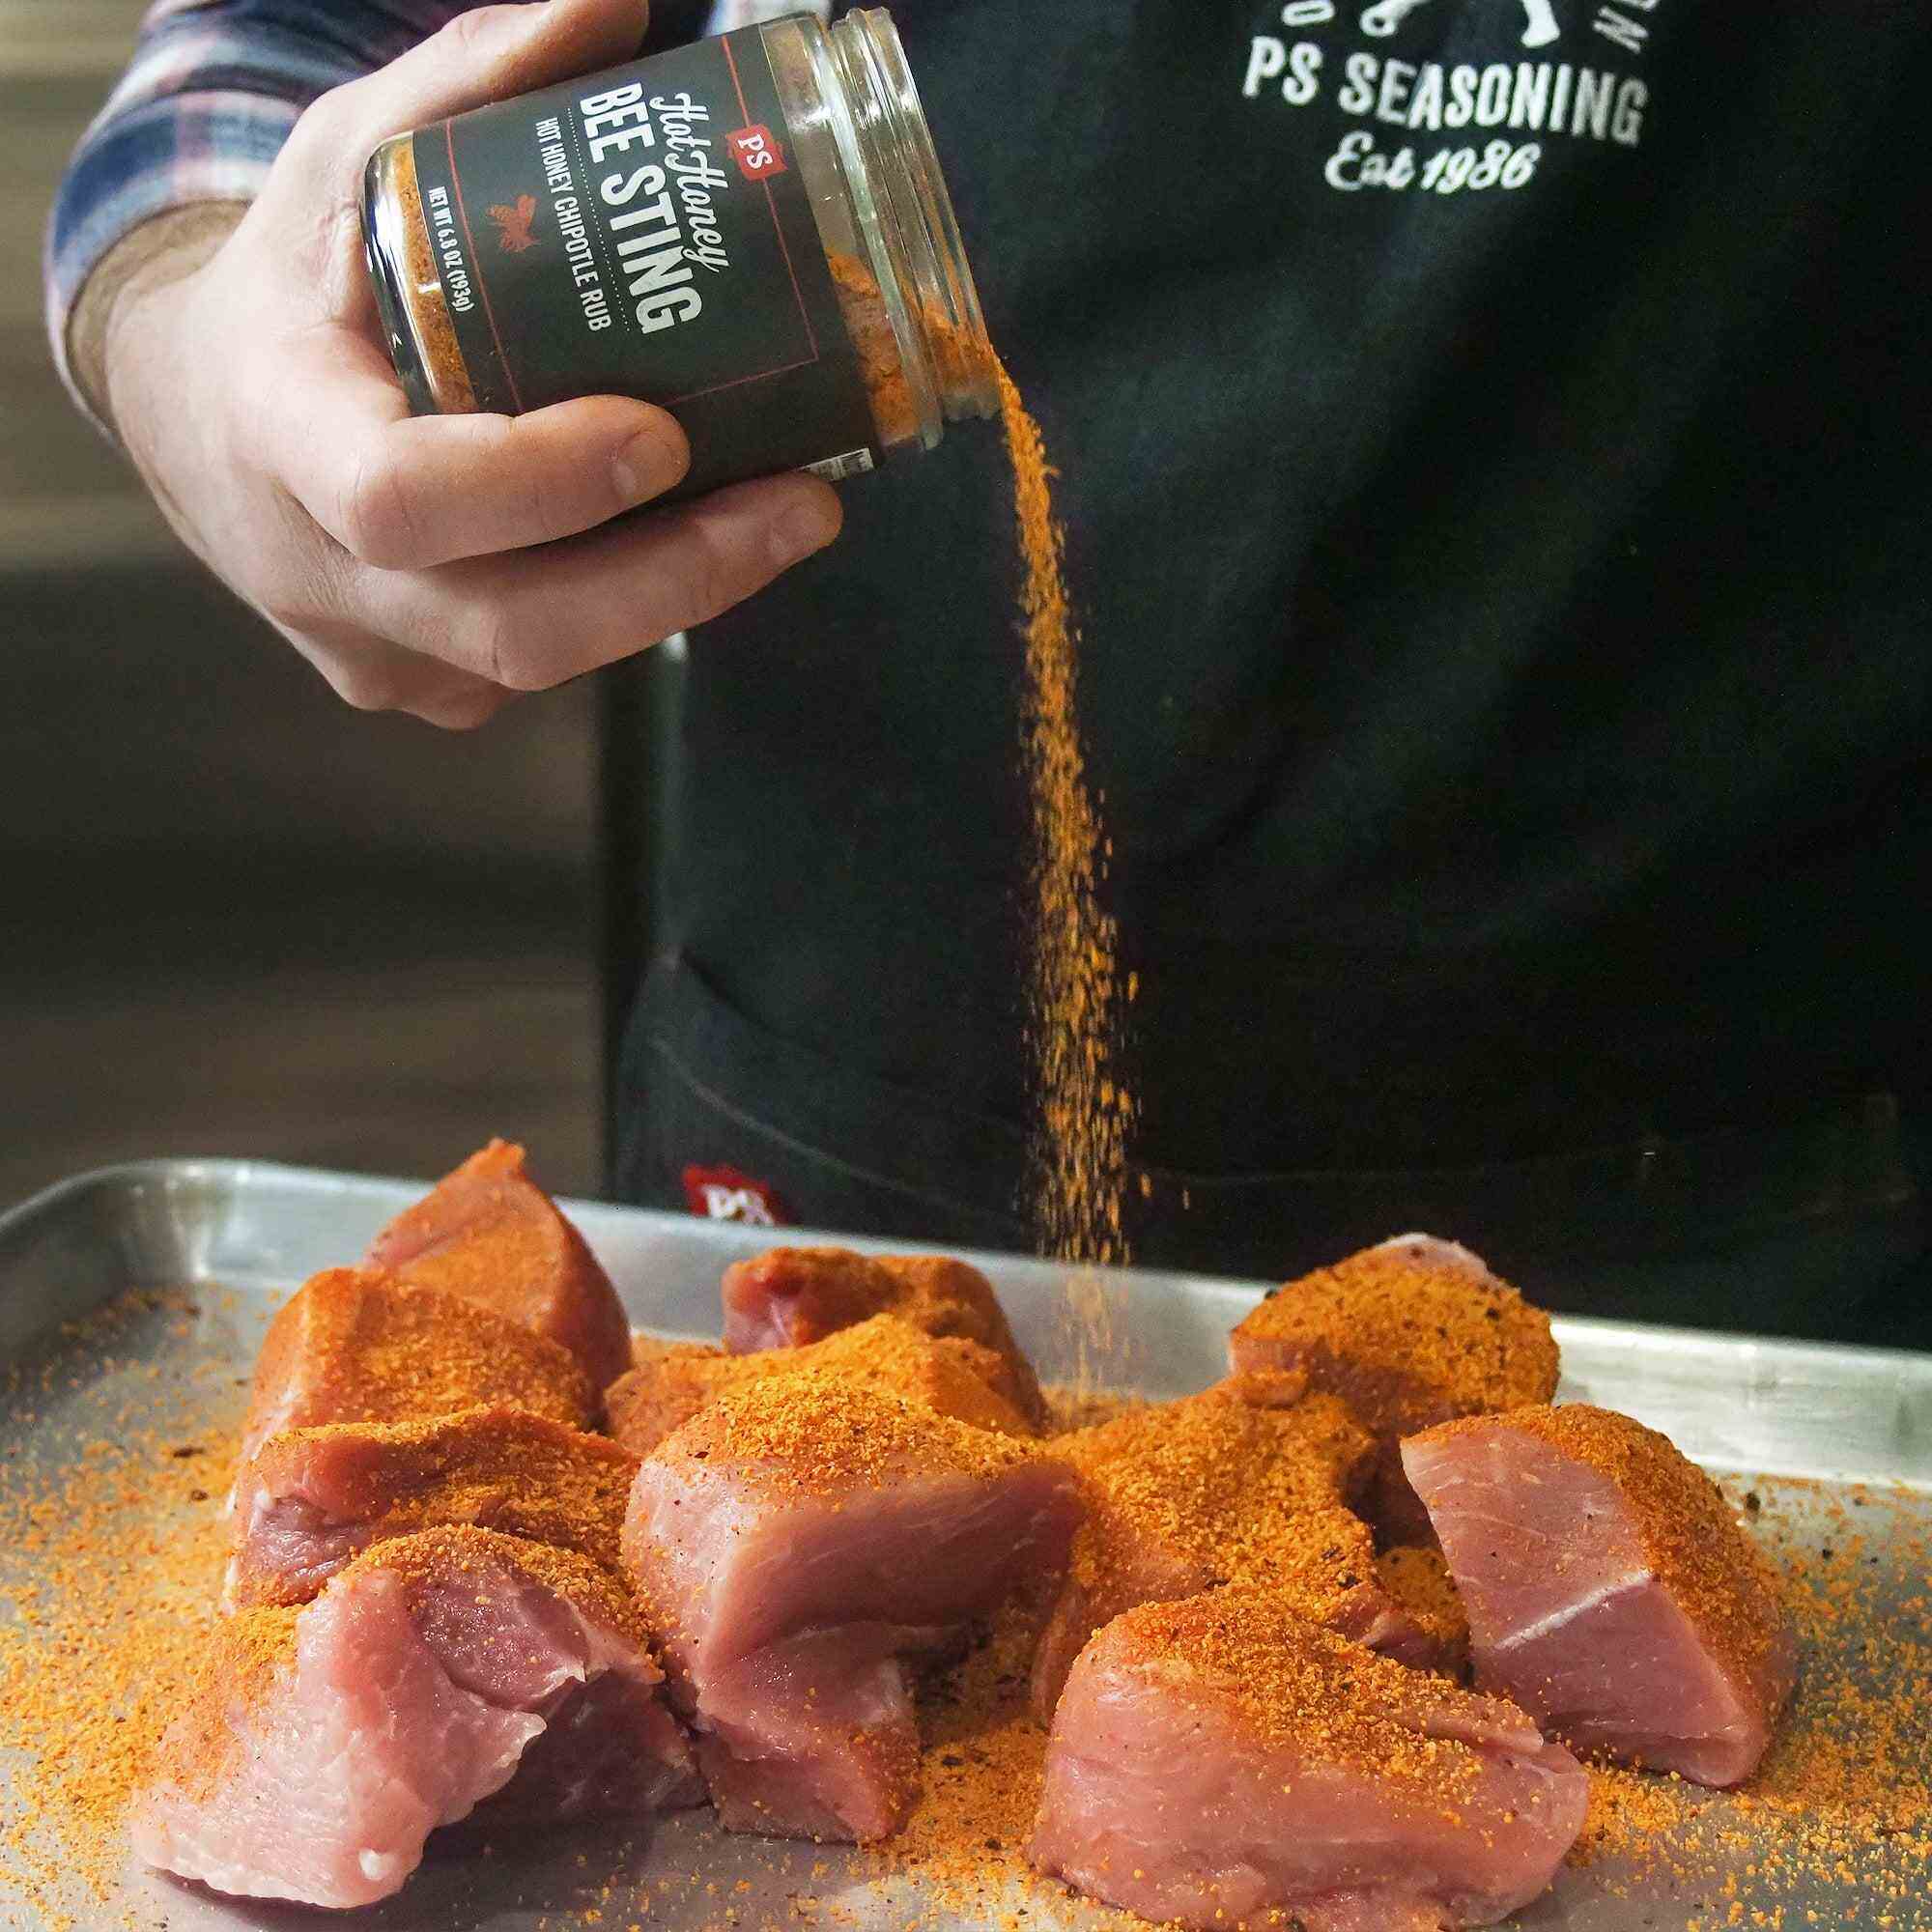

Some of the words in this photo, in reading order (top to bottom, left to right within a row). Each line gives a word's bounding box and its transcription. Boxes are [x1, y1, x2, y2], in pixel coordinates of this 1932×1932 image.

[1242, 36, 1323, 104] PS
[1338, 52, 1649, 146] SEASONING
[535, 117, 561, 143] HOT
[580, 83, 656, 163] BEE
[649, 92, 712, 152] Hot
[541, 142, 574, 193] HONEY
[738, 134, 773, 170] PS
[1420, 139, 1541, 194] 1986
[428, 185, 449, 208] NET
[434, 207, 453, 226] WT
[664, 151, 730, 272] Honey
[438, 229, 458, 249] 6.8
[443, 249, 463, 269] OZ
[554, 196, 599, 288] CHIPOTLE
[600, 165, 703, 334] STING
[446, 270, 475, 312] (193g)
[580, 289, 612, 331] RUB
